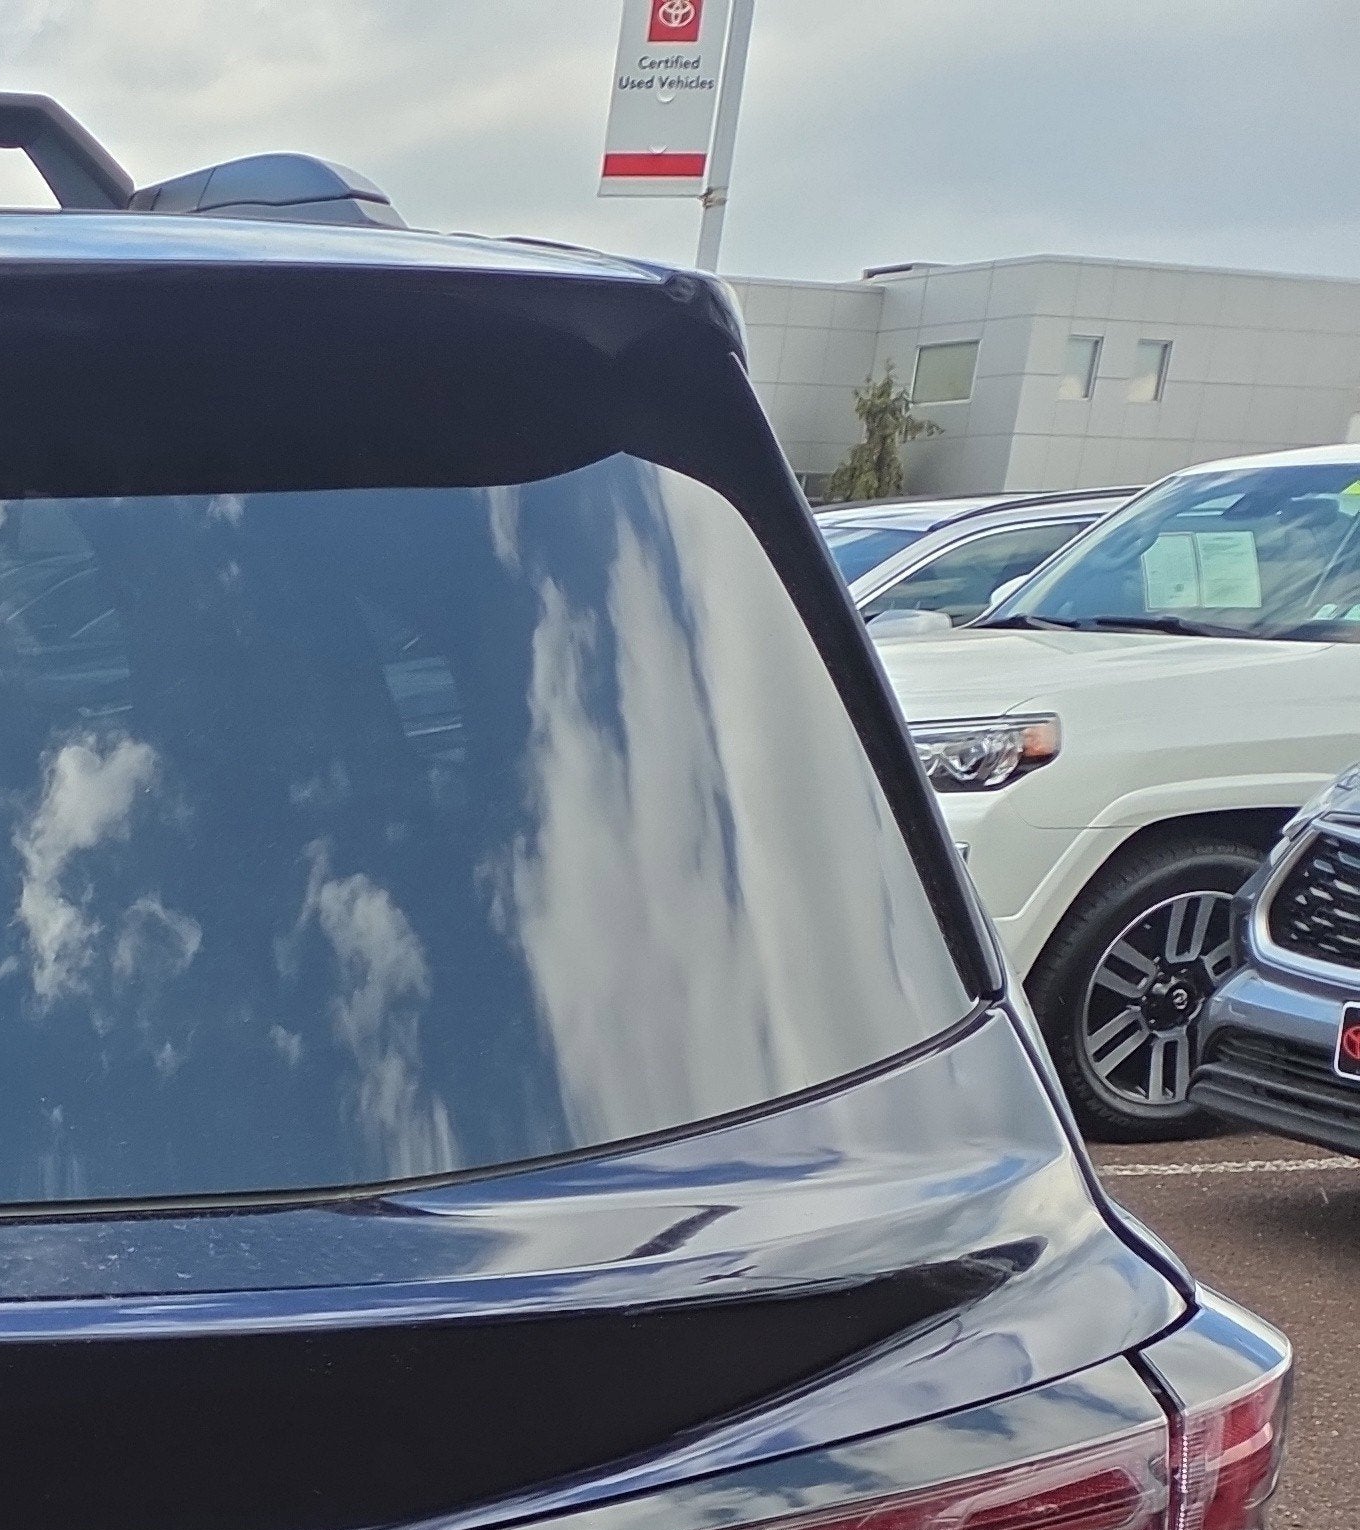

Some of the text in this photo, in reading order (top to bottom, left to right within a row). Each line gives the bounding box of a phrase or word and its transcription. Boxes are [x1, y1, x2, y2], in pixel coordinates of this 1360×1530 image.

[637, 55, 701, 71] Certified
[618, 75, 715, 91] Used Vehicles
